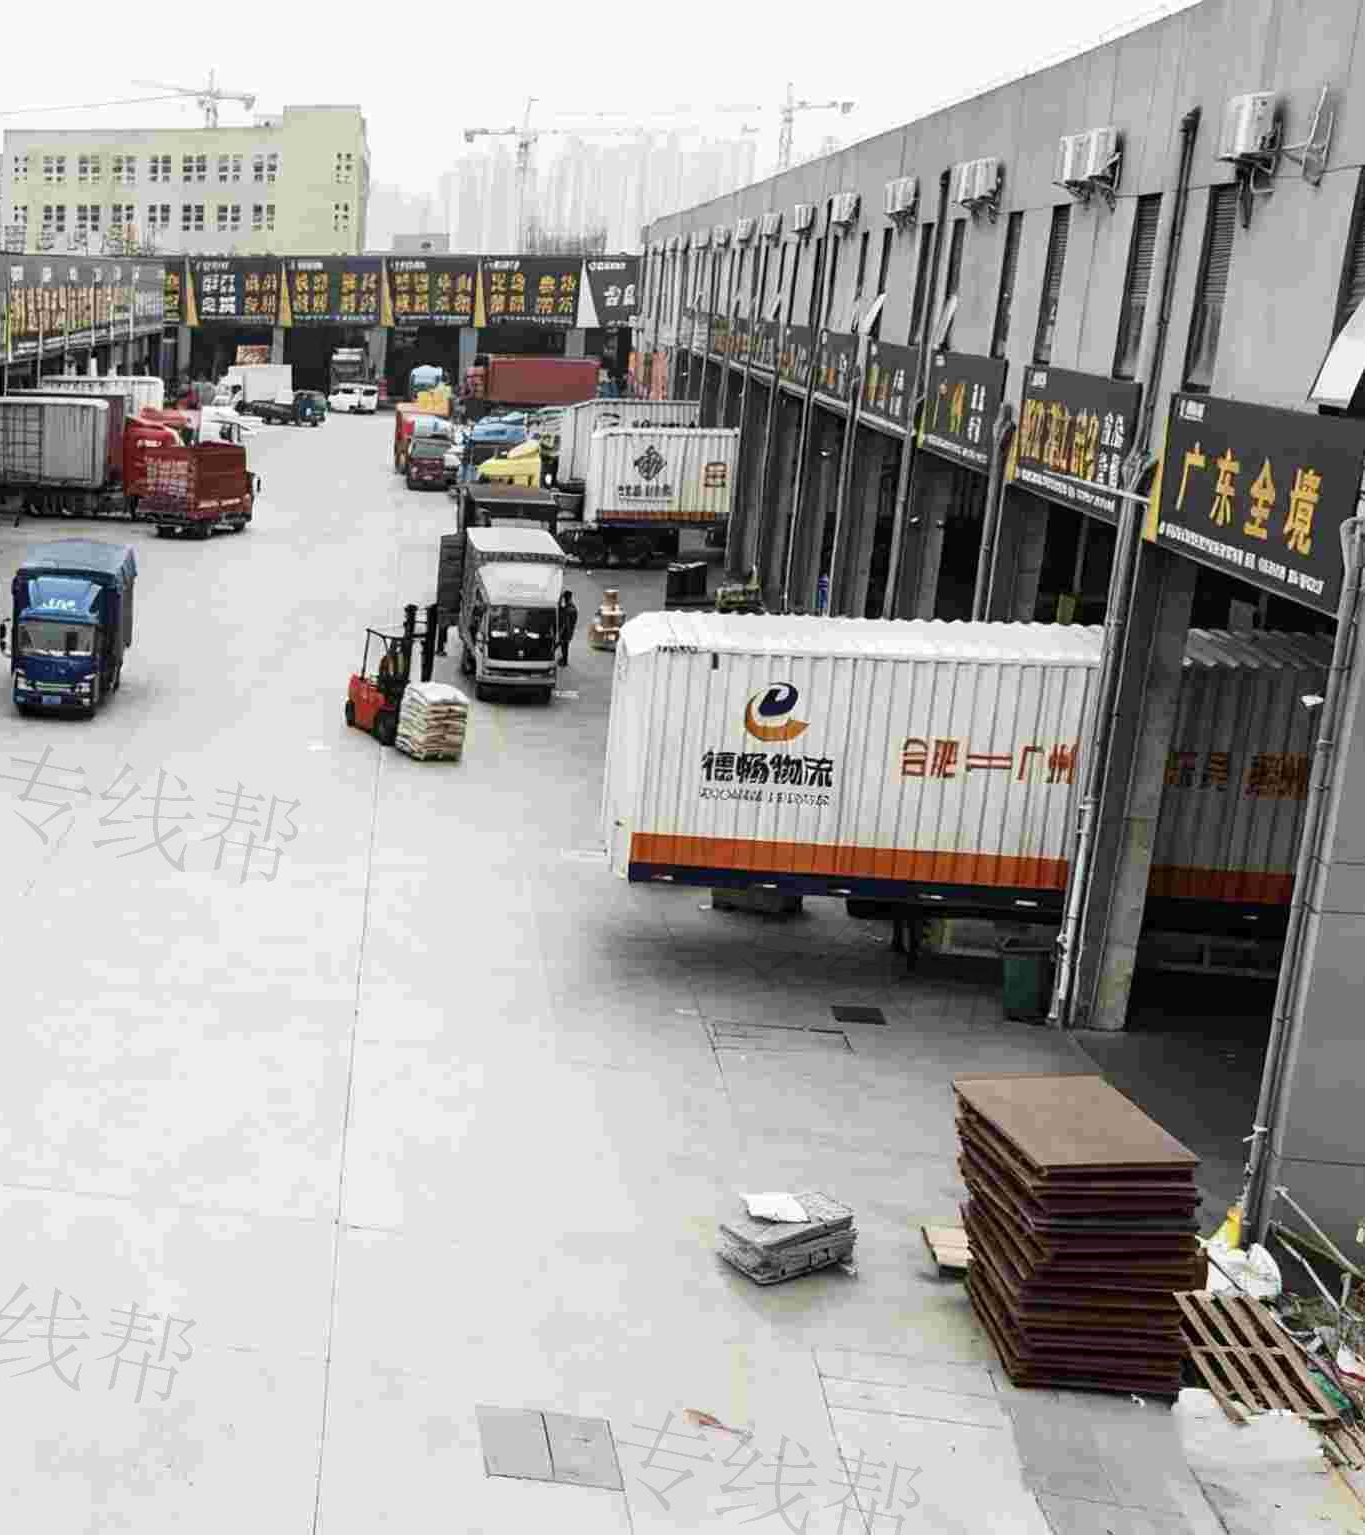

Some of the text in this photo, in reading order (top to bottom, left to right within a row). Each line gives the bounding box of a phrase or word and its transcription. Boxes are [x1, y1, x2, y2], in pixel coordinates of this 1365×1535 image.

[1175, 441, 1324, 555] 广东全境
[701, 750, 834, 788] 德畅物流
